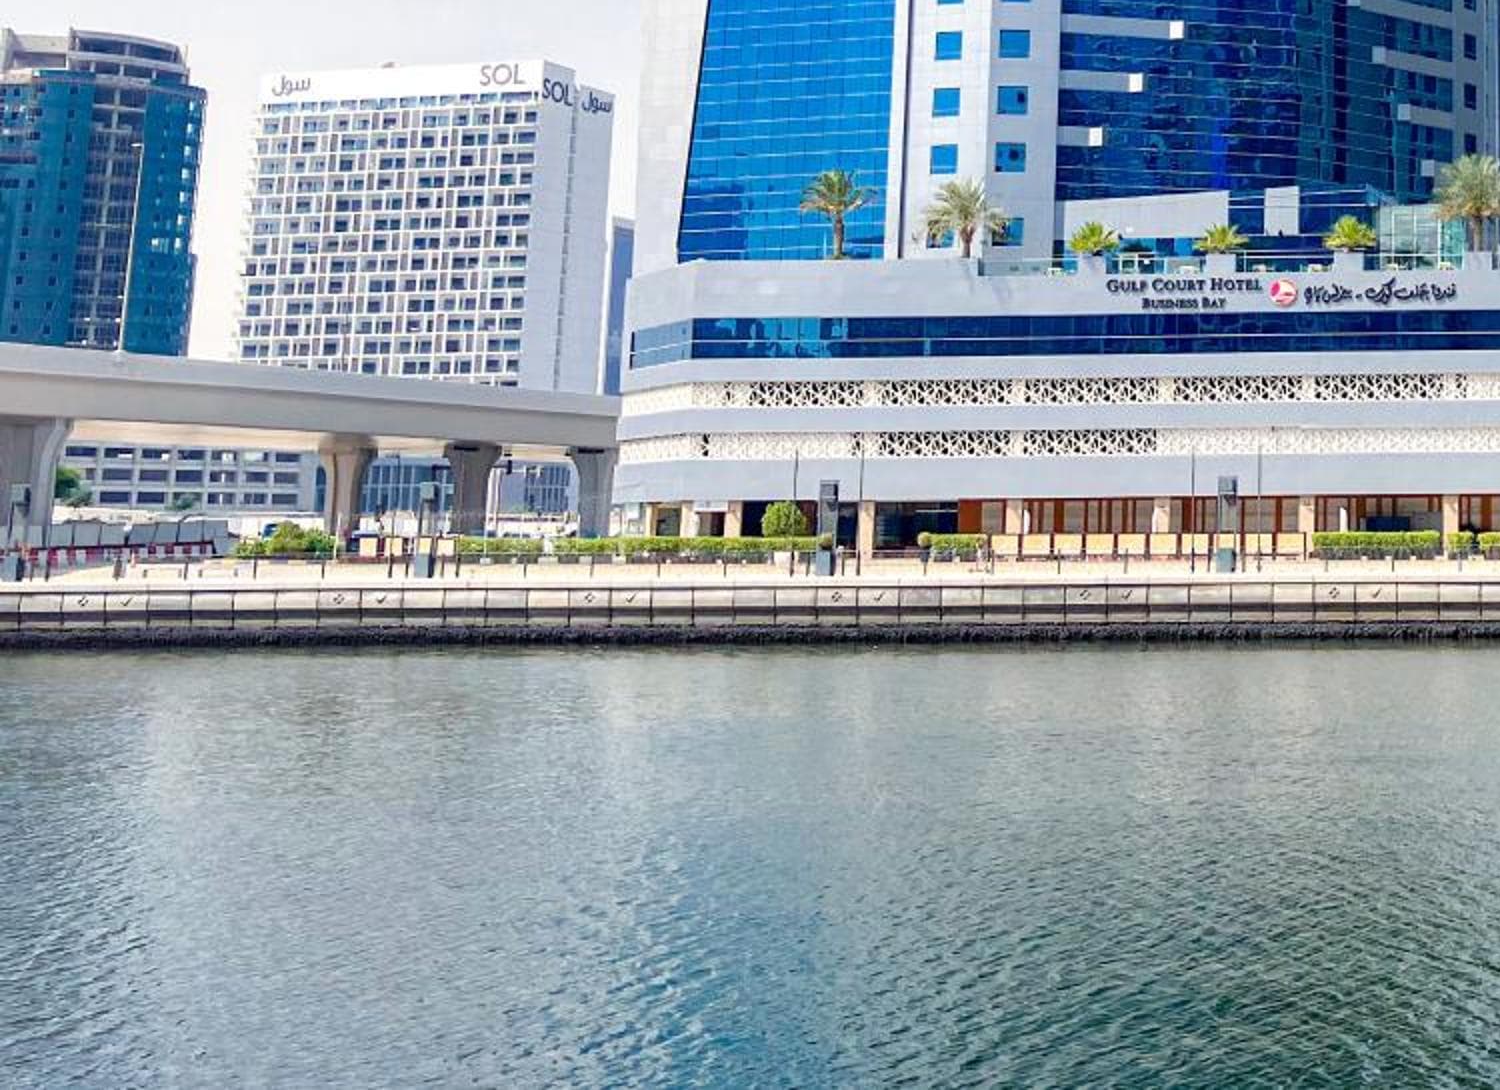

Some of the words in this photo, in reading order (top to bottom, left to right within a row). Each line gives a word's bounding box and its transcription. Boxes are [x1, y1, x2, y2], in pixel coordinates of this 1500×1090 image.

[271, 74, 311, 97] سول
[480, 63, 526, 86] SOL
[542, 78, 573, 107] SOL
[581, 91, 613, 113] سول
[1106, 279, 1148, 293] GULF
[1152, 277, 1206, 292] COURT
[1210, 277, 1263, 291] HOTEL
[1142, 297, 1199, 309] BUSINESS
[1202, 297, 1227, 308] BAY
